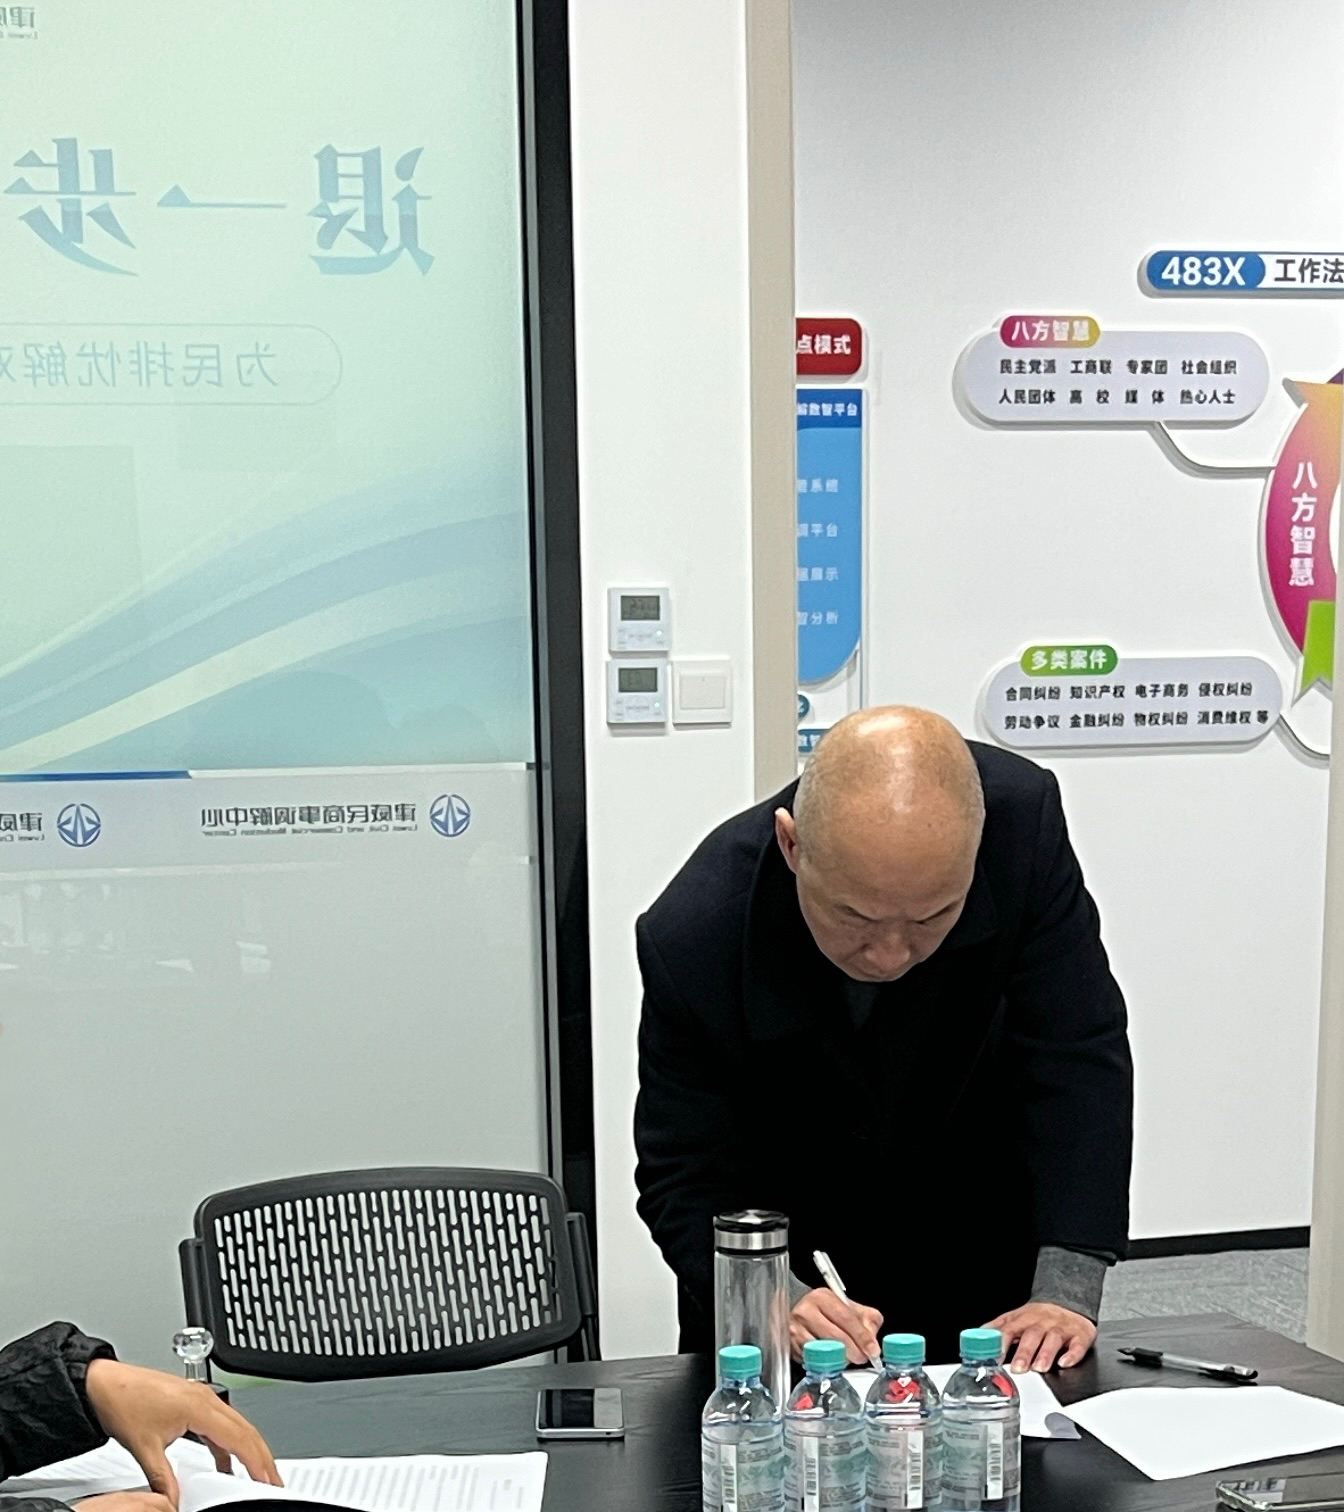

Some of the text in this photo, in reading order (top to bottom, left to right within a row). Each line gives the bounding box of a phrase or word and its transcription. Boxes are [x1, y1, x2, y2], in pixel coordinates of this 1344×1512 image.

[1161, 256, 1344, 286] 483X 工作法
[1011, 320, 1090, 341] 八方智慧
[796, 334, 851, 355] 点模式
[999, 359, 1237, 375] 民主党派 工商联 专家团 社会组织
[999, 388, 1056, 404] 人民团体
[1180, 389, 1236, 404] 热心人士
[1288, 461, 1318, 586] 八方智慧
[1031, 649, 1107, 670] 多类案件
[1005, 681, 1253, 702] 合同纠纷 知识产权 电子商务 侵权纠纷
[1004, 715, 1060, 730] 劳动争议
[1069, 712, 1125, 729] 金融纠纷
[1134, 711, 1188, 727] 物权纠纷
[1197, 710, 1251, 726] 消费维权
